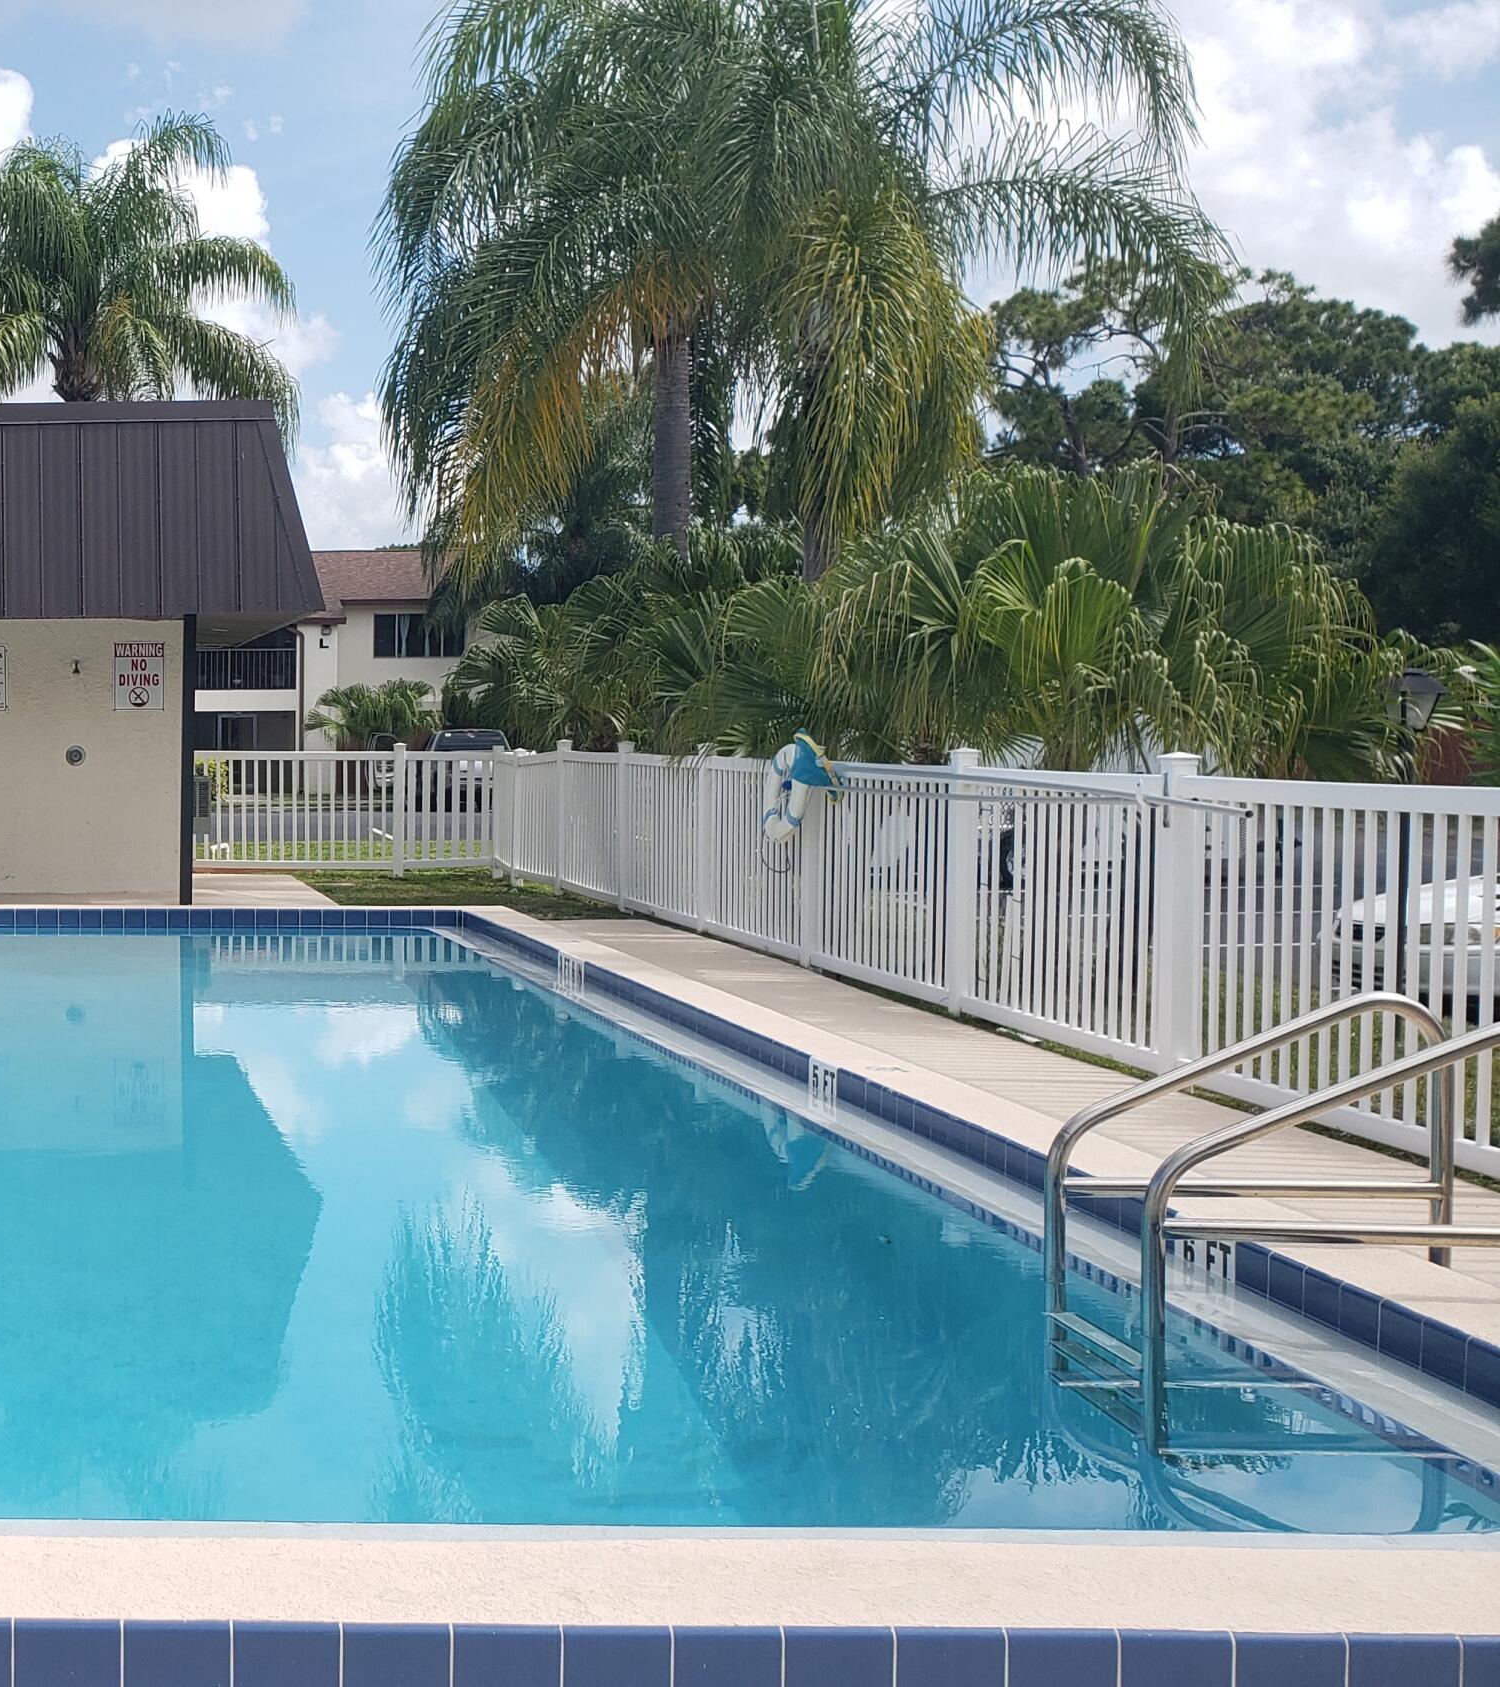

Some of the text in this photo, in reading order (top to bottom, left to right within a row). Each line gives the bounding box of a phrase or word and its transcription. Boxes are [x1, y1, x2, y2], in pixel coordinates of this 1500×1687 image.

[319, 638, 329, 648] L
[115, 644, 163, 657] WARNING
[131, 659, 147, 671] NO
[119, 674, 159, 686] DIVING
[812, 1064, 819, 1088] 5
[1183, 1240, 1195, 1263] 6
